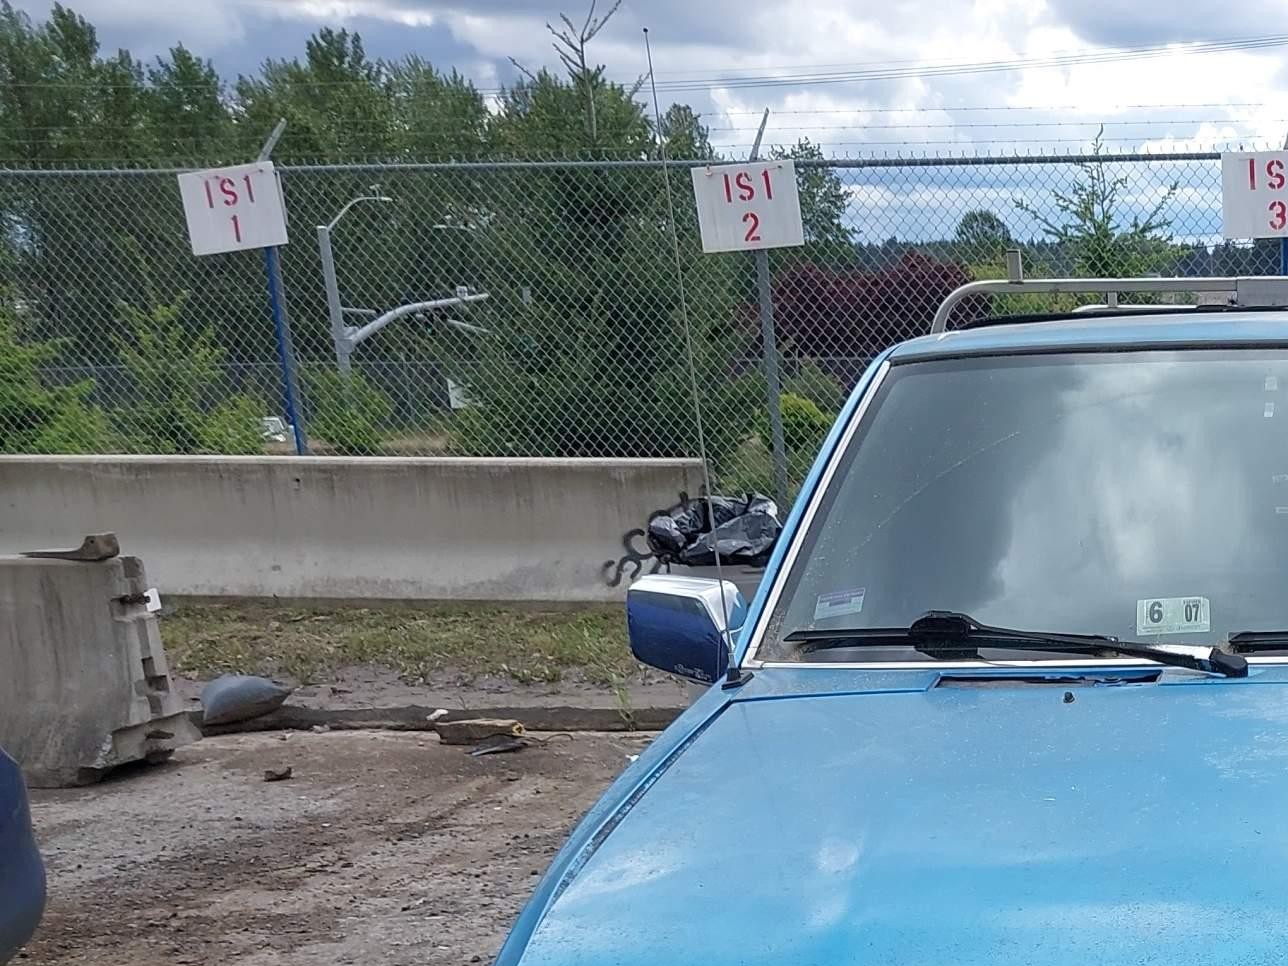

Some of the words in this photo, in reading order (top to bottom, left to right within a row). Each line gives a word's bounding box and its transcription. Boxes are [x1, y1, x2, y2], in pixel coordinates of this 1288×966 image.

[231, 214, 241, 243] 1
[742, 212, 761, 242] 2
[1268, 200, 1286, 230] 3
[1149, 601, 1163, 624] 6
[1184, 604, 1200, 622] 07
